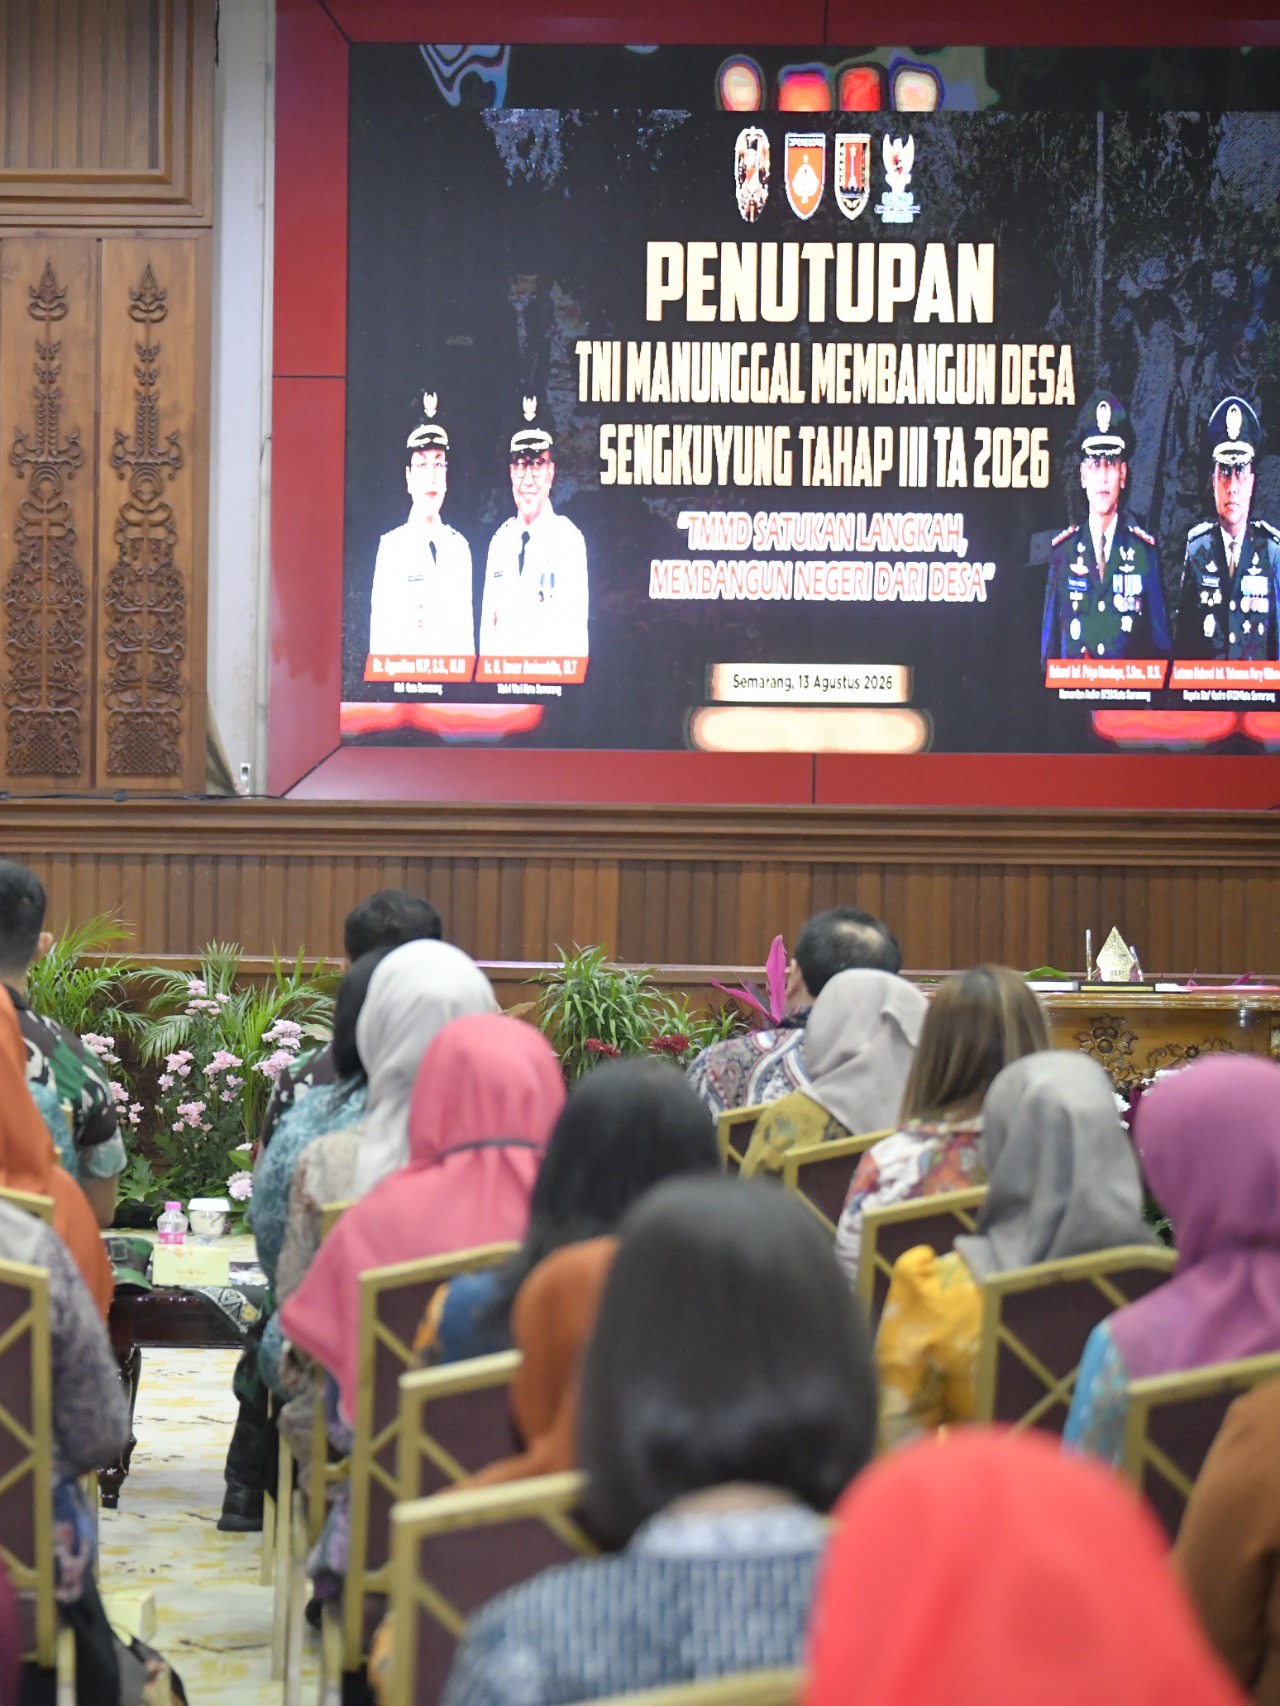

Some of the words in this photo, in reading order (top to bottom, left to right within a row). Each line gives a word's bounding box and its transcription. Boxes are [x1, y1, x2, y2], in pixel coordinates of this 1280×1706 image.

[646, 241, 994, 323] PENUTUPAN
[575, 340, 621, 402] TNI
[626, 341, 806, 403] MANUNGGAL
[811, 343, 996, 405] MEMBANGUN
[1001, 344, 1075, 405] DESA
[600, 424, 792, 486] SENGKUYUNG
[798, 426, 893, 487] TAHAP
[899, 427, 928, 487] III
[933, 427, 968, 487] TA
[973, 427, 1050, 488] 2026
[753, 511, 855, 551] SATUKAN
[856, 512, 968, 558] LANGKAH,
[649, 559, 793, 600] MEMBANGUN
[794, 560, 873, 601] NEGERI
[874, 562, 928, 602] DARI
[733, 673, 795, 691] Semarang,
[798, 674, 810, 689] 13
[813, 675, 860, 692] Agustus
[864, 675, 893, 690] 2026
